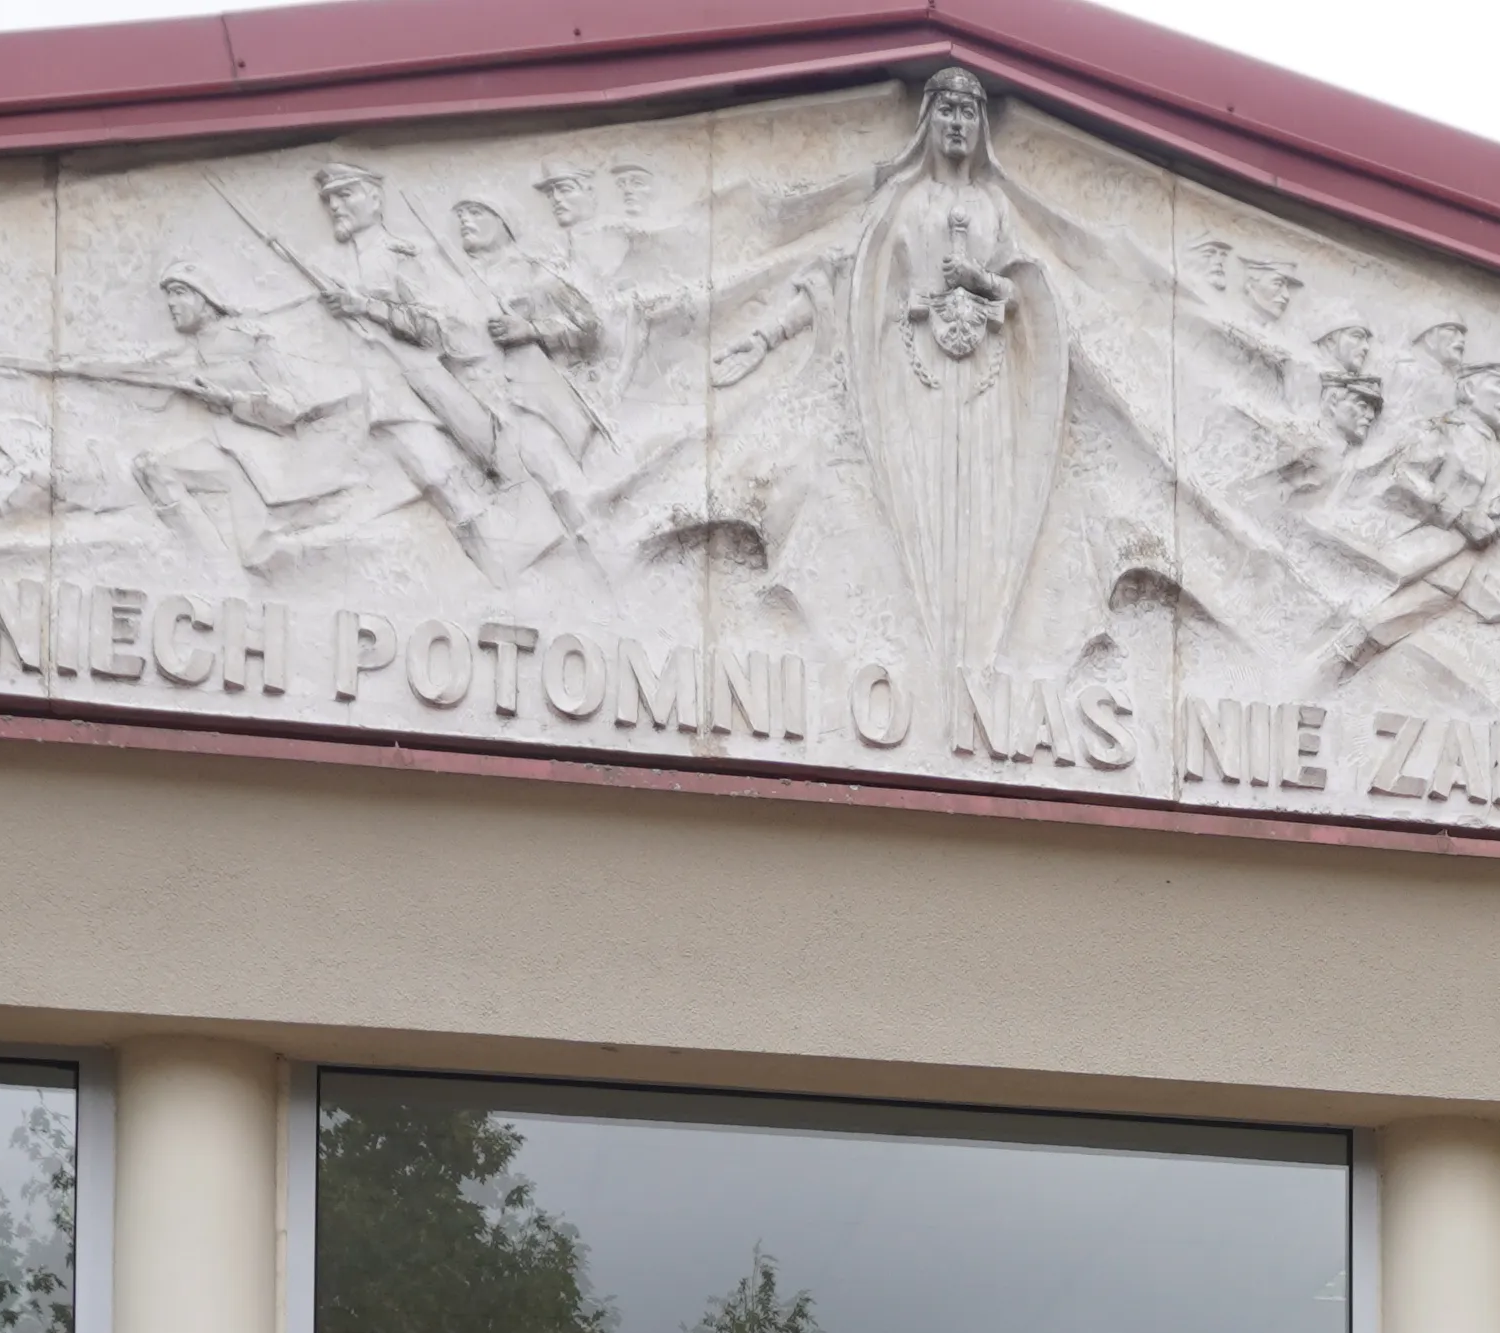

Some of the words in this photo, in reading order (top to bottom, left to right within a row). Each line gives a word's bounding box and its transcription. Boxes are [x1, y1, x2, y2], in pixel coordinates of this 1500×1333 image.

[333, 608, 807, 741] POTOMNI
[847, 661, 913, 749] O
[952, 663, 1135, 771] NAS
[1184, 696, 1327, 792] NIE
